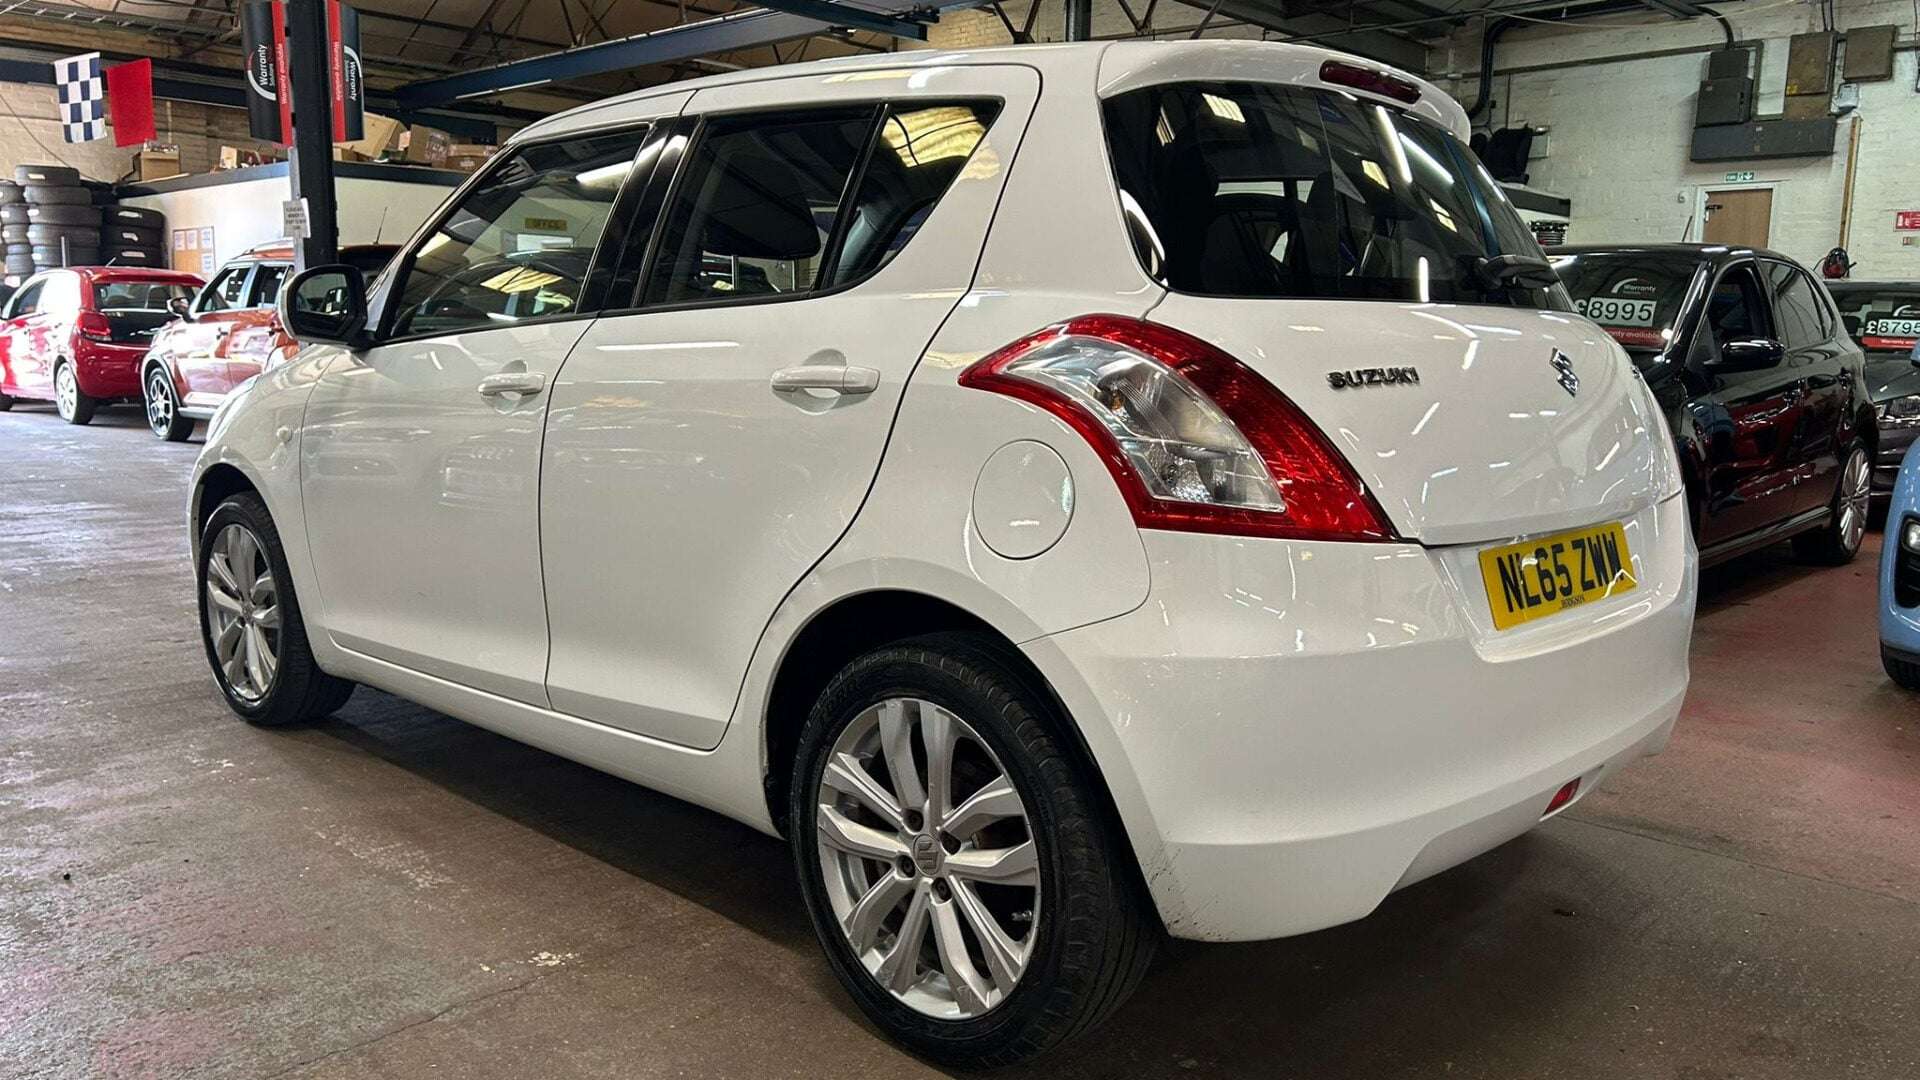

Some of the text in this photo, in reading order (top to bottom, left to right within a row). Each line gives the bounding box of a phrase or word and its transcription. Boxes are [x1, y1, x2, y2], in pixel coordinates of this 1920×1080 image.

[257, 44, 268, 87] Warranty
[350, 61, 358, 101] Warranty
[1326, 367, 1419, 389] SUZUKI
[1497, 531, 1624, 613] NL65 ZWW
